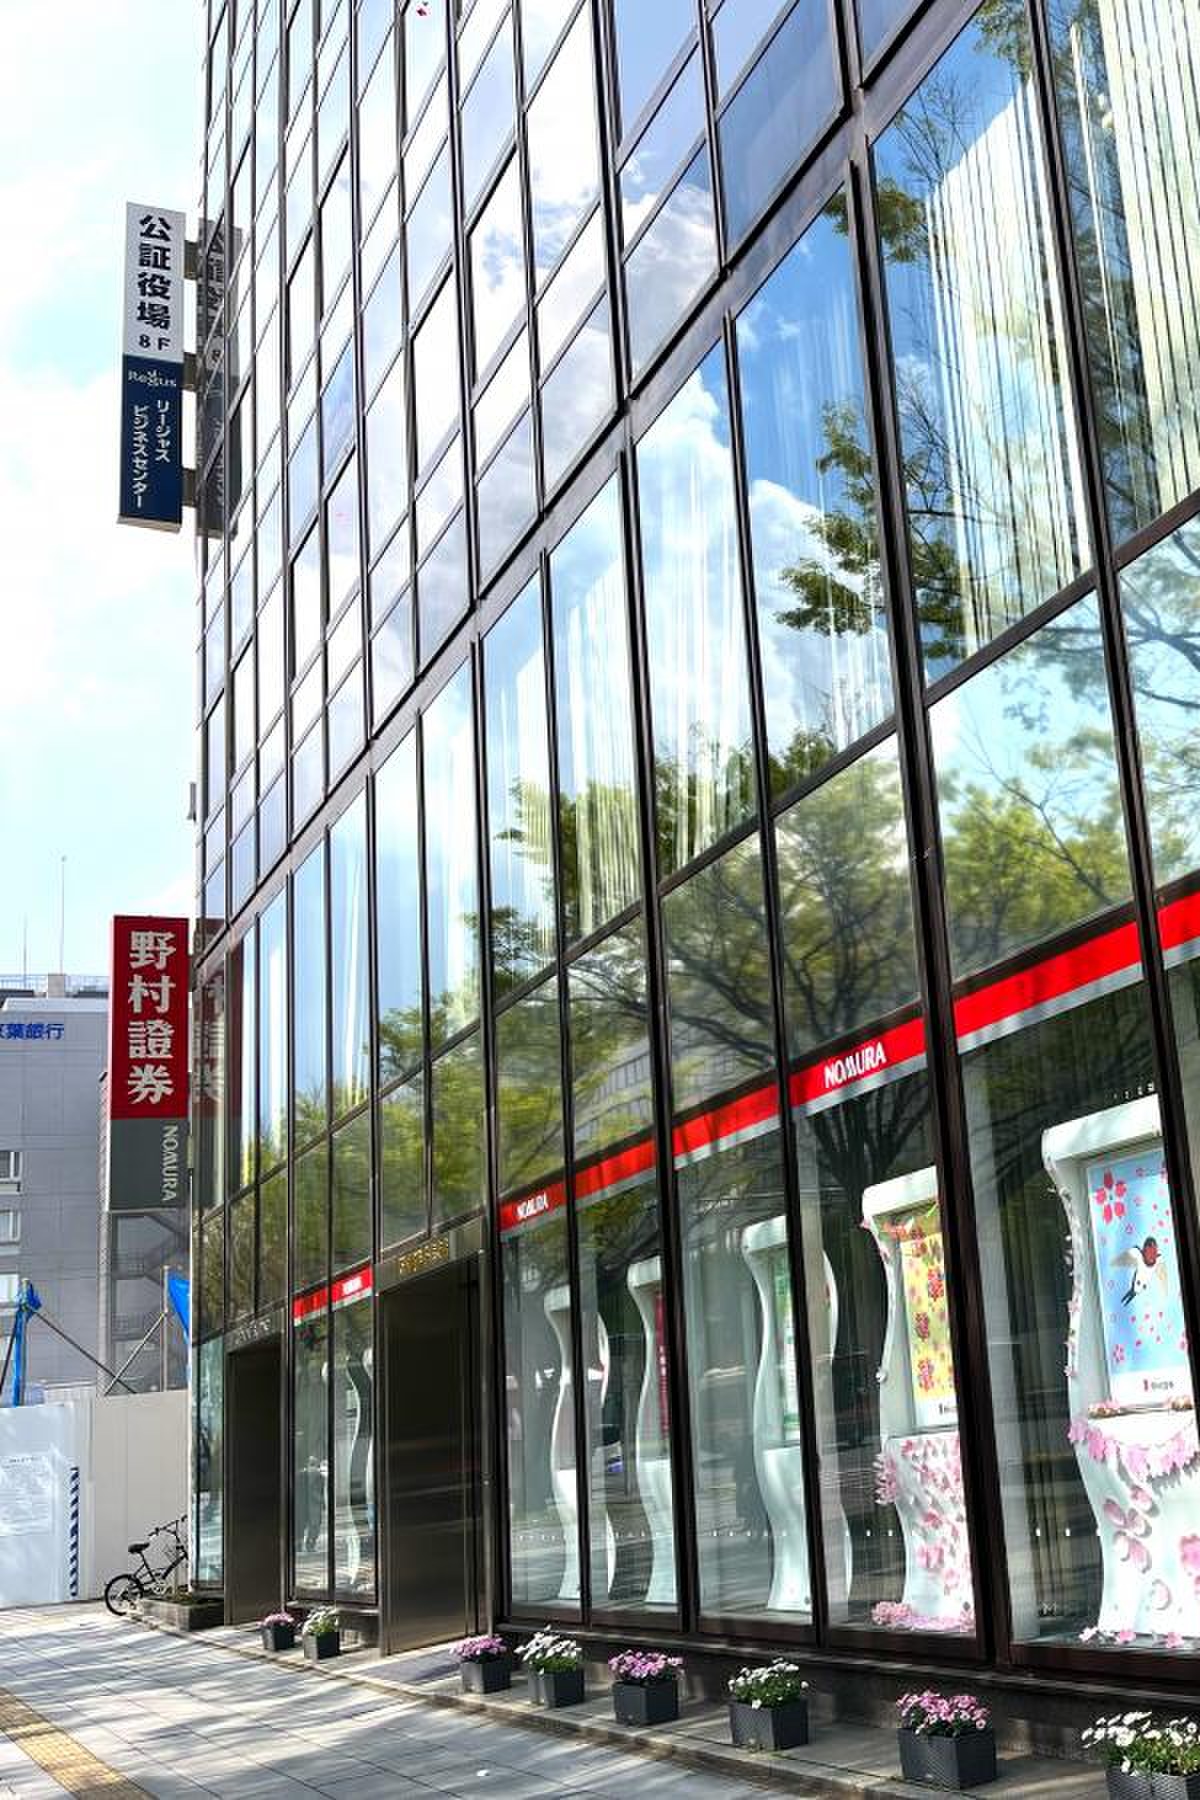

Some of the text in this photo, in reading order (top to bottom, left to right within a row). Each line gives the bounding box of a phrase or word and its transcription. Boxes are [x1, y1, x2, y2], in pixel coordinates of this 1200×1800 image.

[137, 214, 172, 330] 公証役場
[132, 404, 150, 509] ビジネスセンター
[155, 399, 171, 463] リージャス
[127, 930, 177, 1105] 野村證券
[823, 1041, 887, 1089] NOMURA
[161, 1124, 179, 1202] NOMURA
